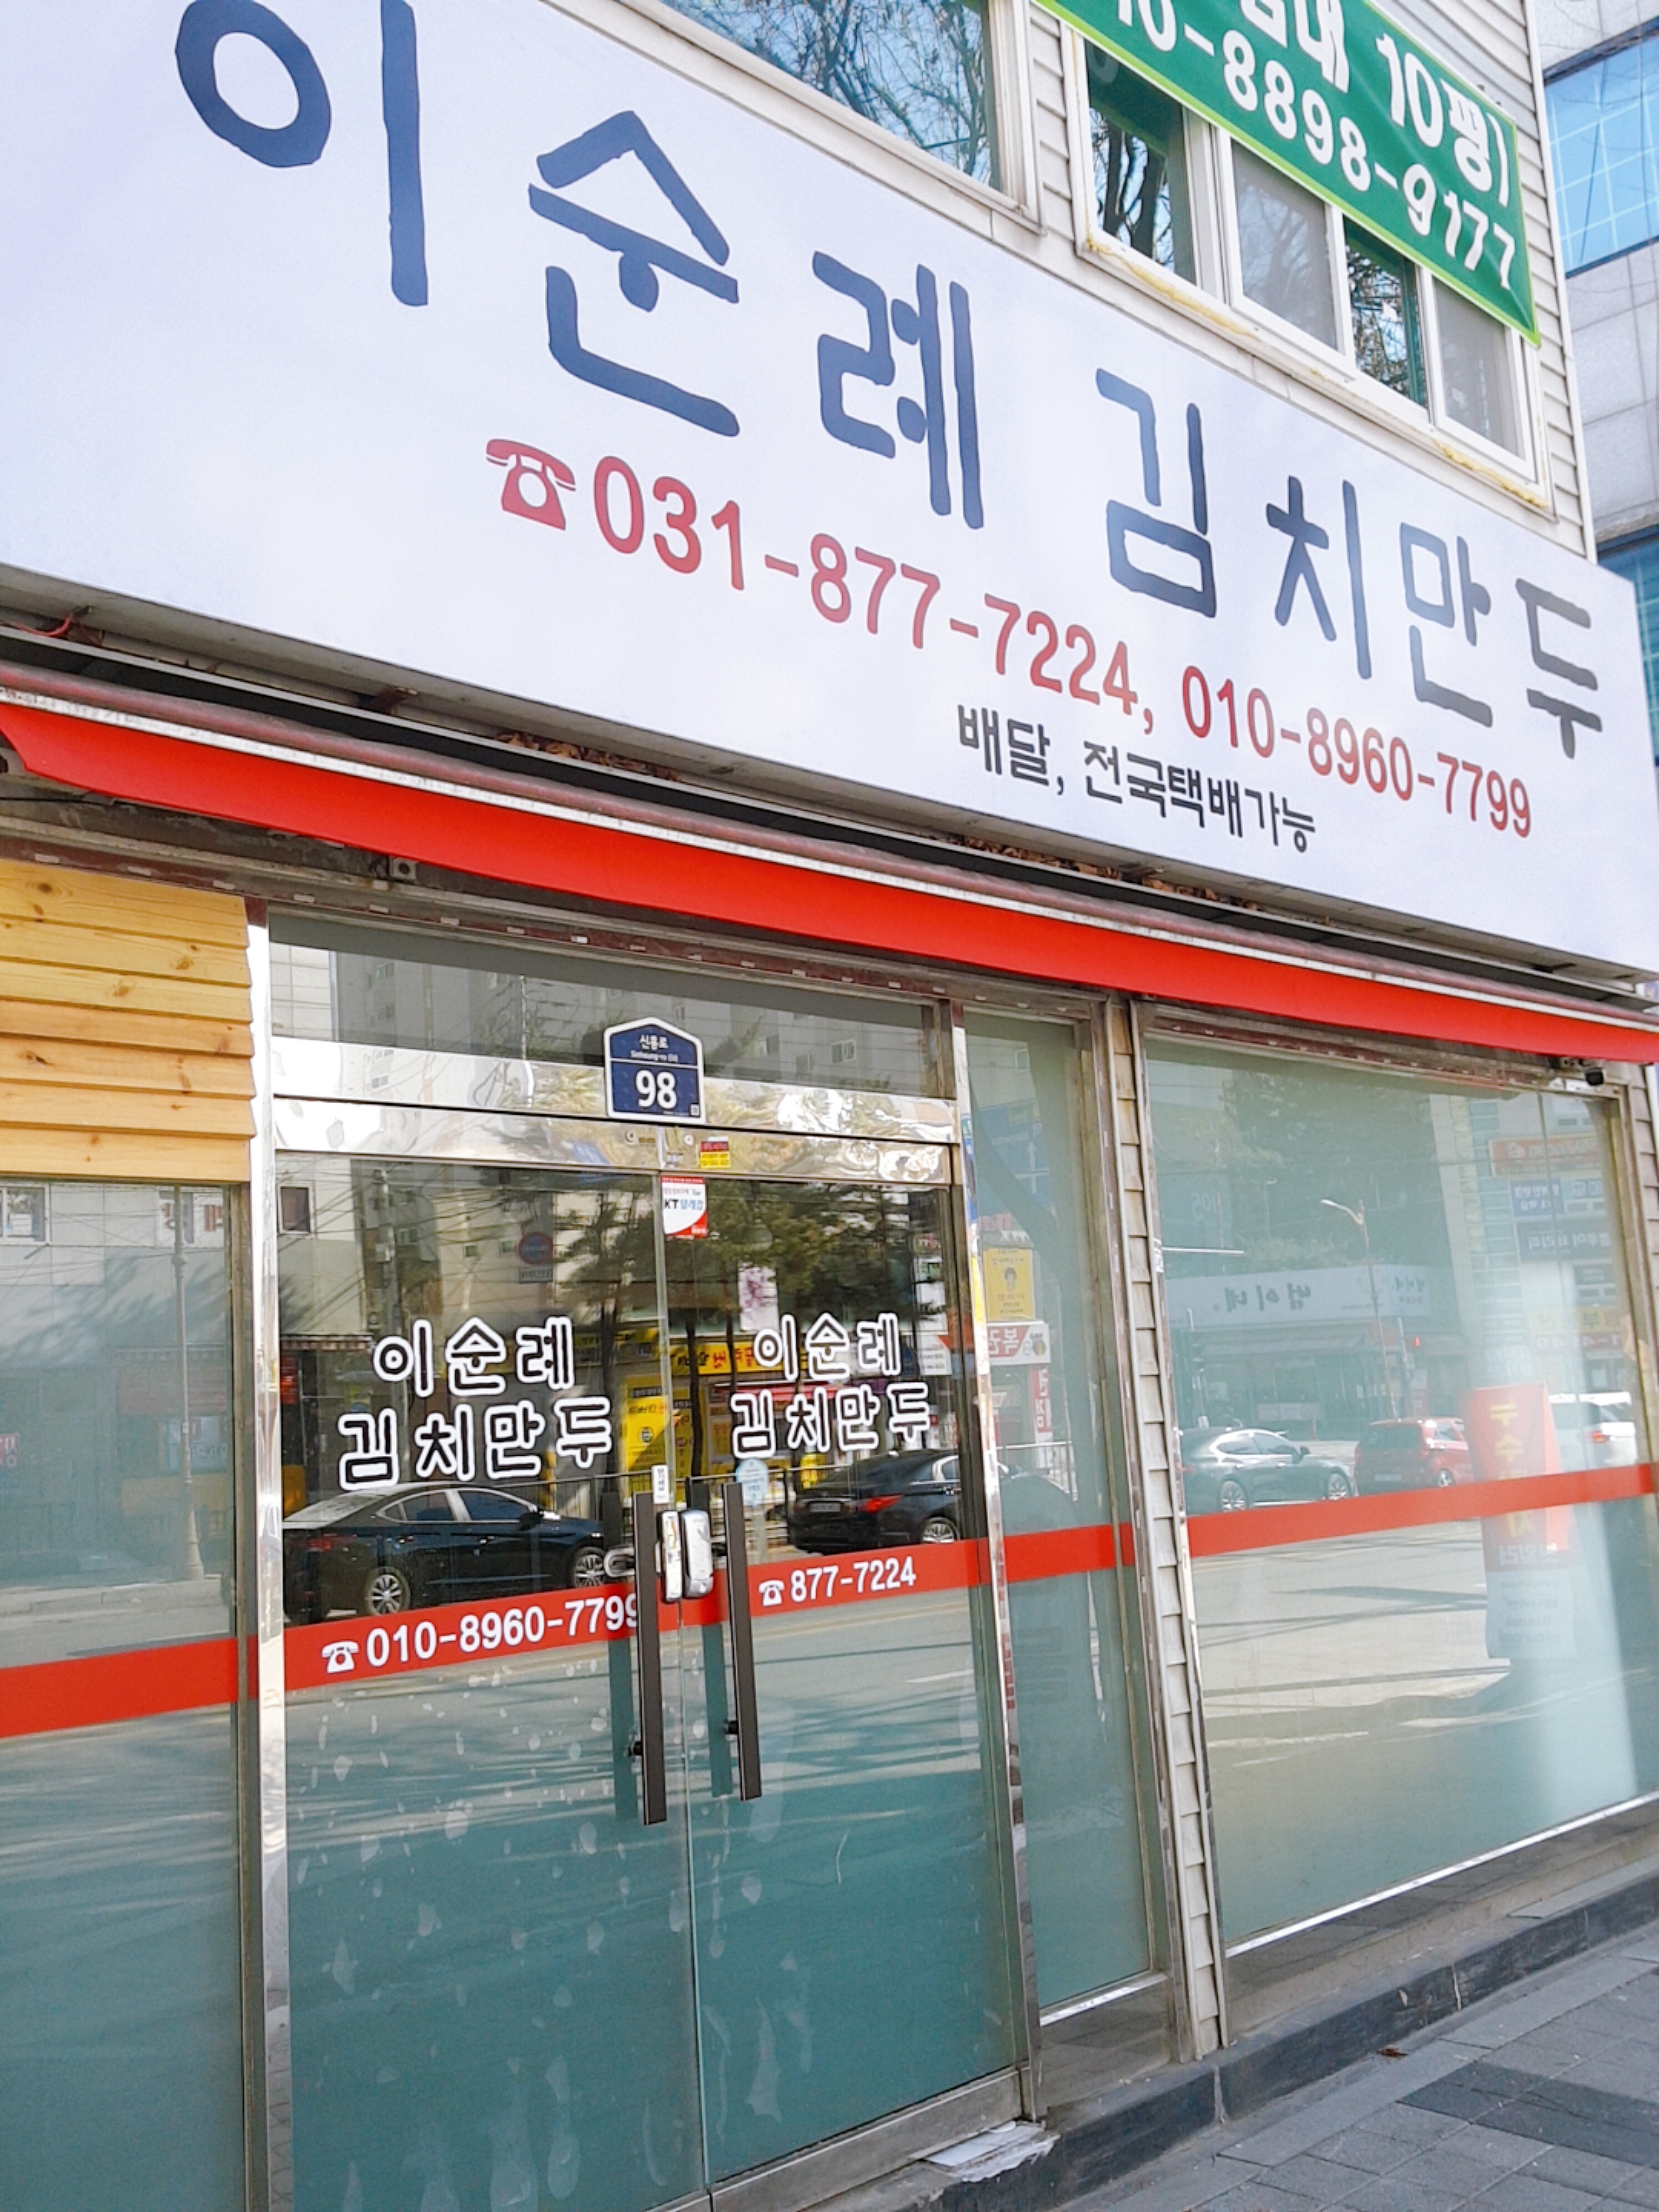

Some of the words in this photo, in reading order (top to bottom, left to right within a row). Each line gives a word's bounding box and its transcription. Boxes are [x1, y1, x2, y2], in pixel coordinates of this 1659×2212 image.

[175, 0, 984, 529] 이순례
[1096, 368, 1602, 758] 김치만두
[593, 456, 1155, 734] 031-877-7224,
[1182, 666, 1532, 837] 010-8960-7799
[957, 705, 1064, 796] 배달,
[1083, 738, 1315, 853] 전국택배가능
[636, 1069, 677, 1109] 98
[338, 1396, 612, 1491] 김치만두
[730, 1382, 931, 1459] 김치만두
[790, 1555, 917, 1603] 877-7224
[366, 1595, 637, 1666] 010-8960-7799
